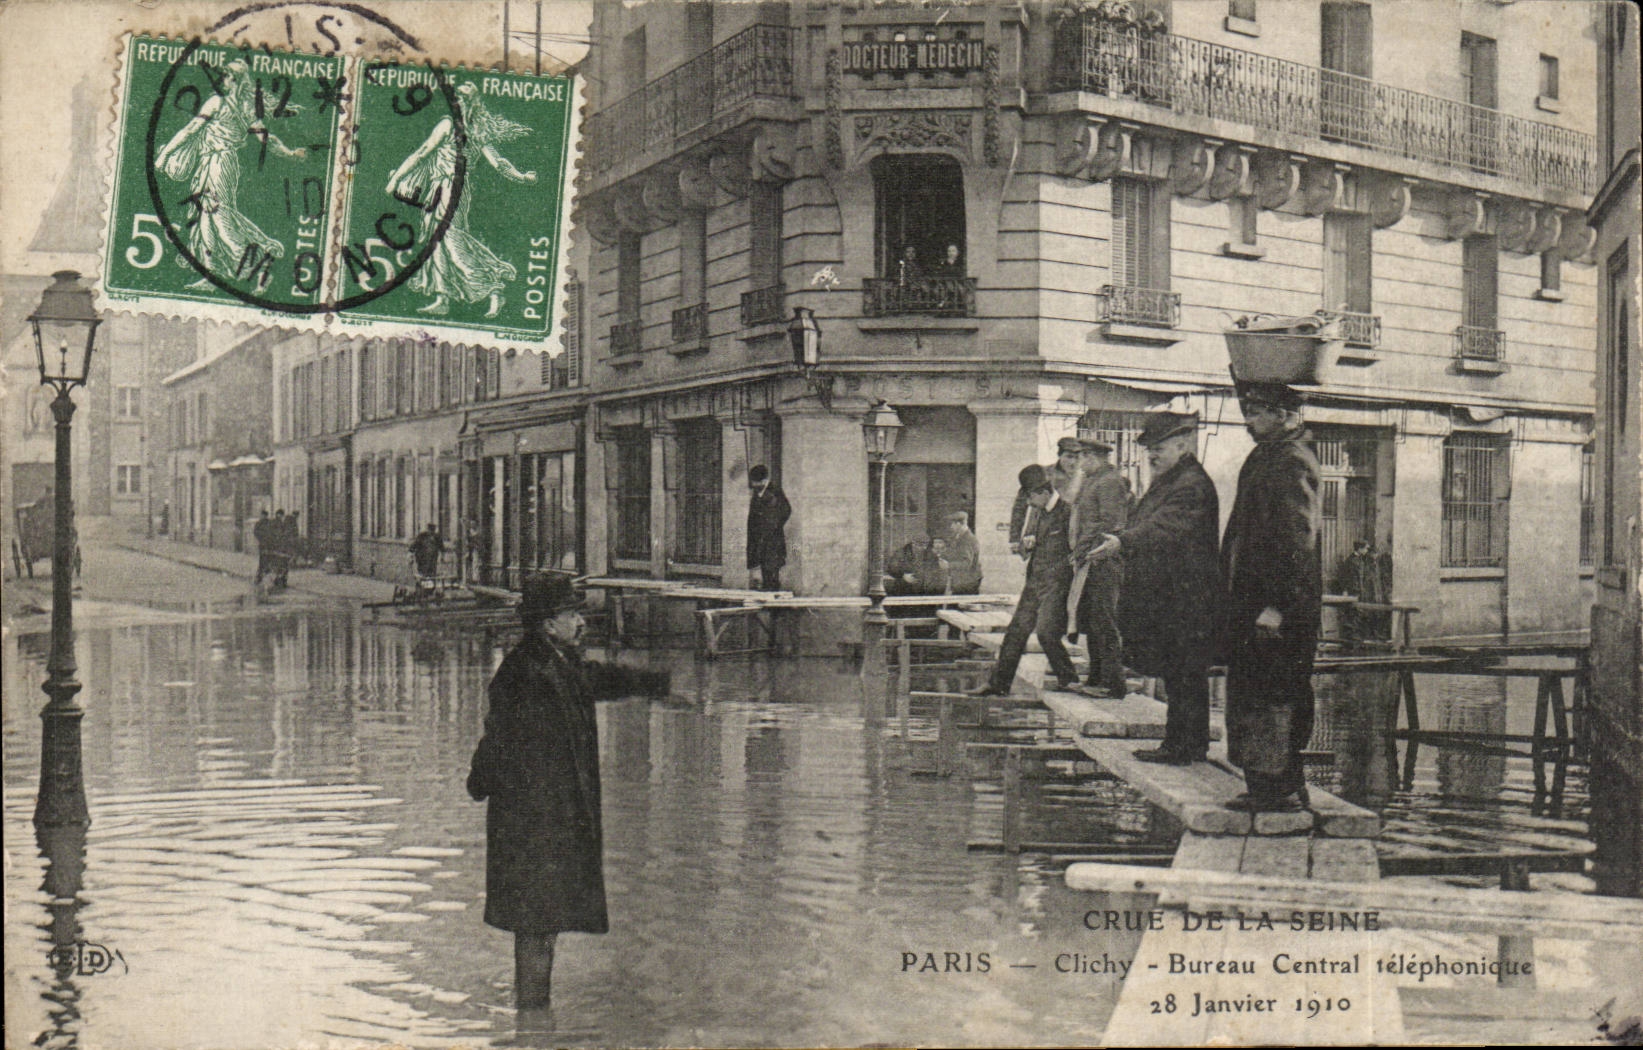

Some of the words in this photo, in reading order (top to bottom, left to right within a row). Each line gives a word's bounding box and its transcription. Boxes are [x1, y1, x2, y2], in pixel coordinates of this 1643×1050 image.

[253, 55, 334, 79] FRANÇAISE
[483, 77, 564, 102] FRANÇAISE
[291, 215, 318, 297] POTES
[523, 236, 550, 320] POSTES
